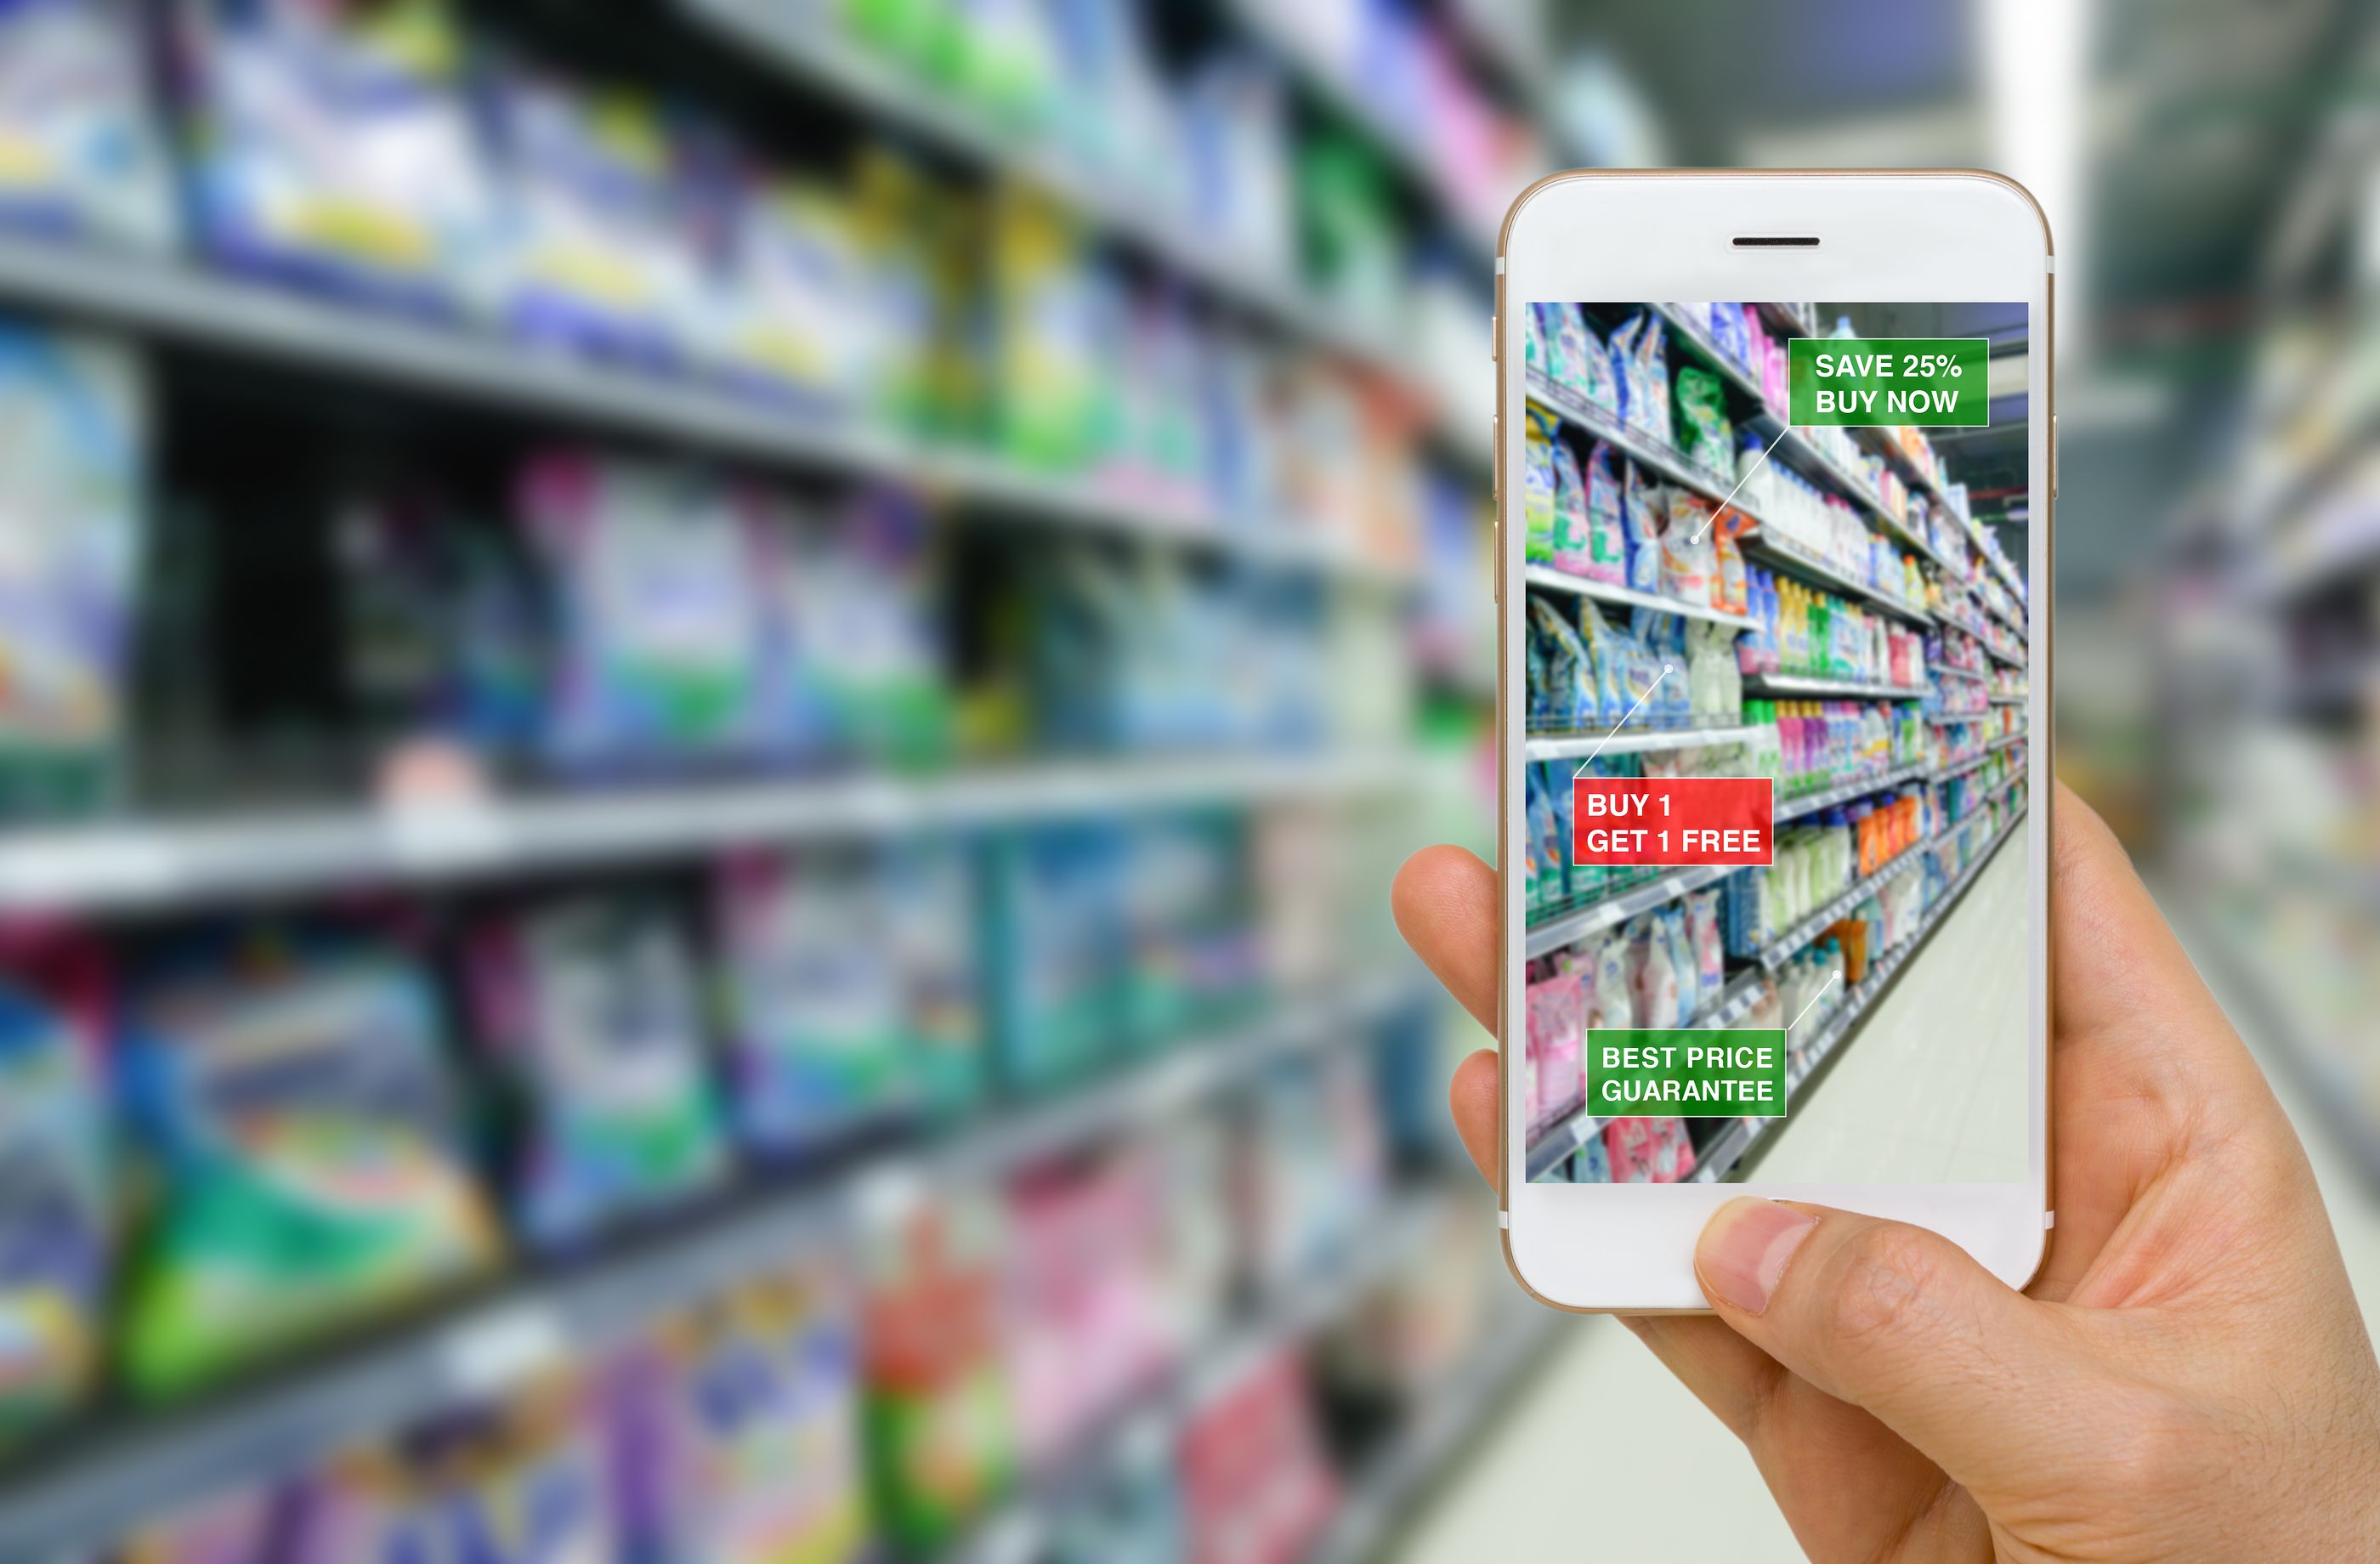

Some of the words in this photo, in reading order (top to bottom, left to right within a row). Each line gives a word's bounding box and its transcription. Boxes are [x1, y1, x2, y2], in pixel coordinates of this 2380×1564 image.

[1816, 354, 1894, 377] SAVE
[1903, 354, 1963, 378] 25%
[1816, 390, 1878, 414] BUY
[1887, 389, 1959, 414] NOW
[1588, 793, 1650, 817] BUY
[1658, 794, 1670, 817] 1
[1587, 829, 1648, 853] GET
[1658, 830, 1669, 853] 1
[1682, 829, 1761, 853] FREE
[1602, 1046, 1677, 1068] BEST
[1687, 1046, 1773, 1069] PRICE
[1601, 1080, 1774, 1102] GUARANTEE
